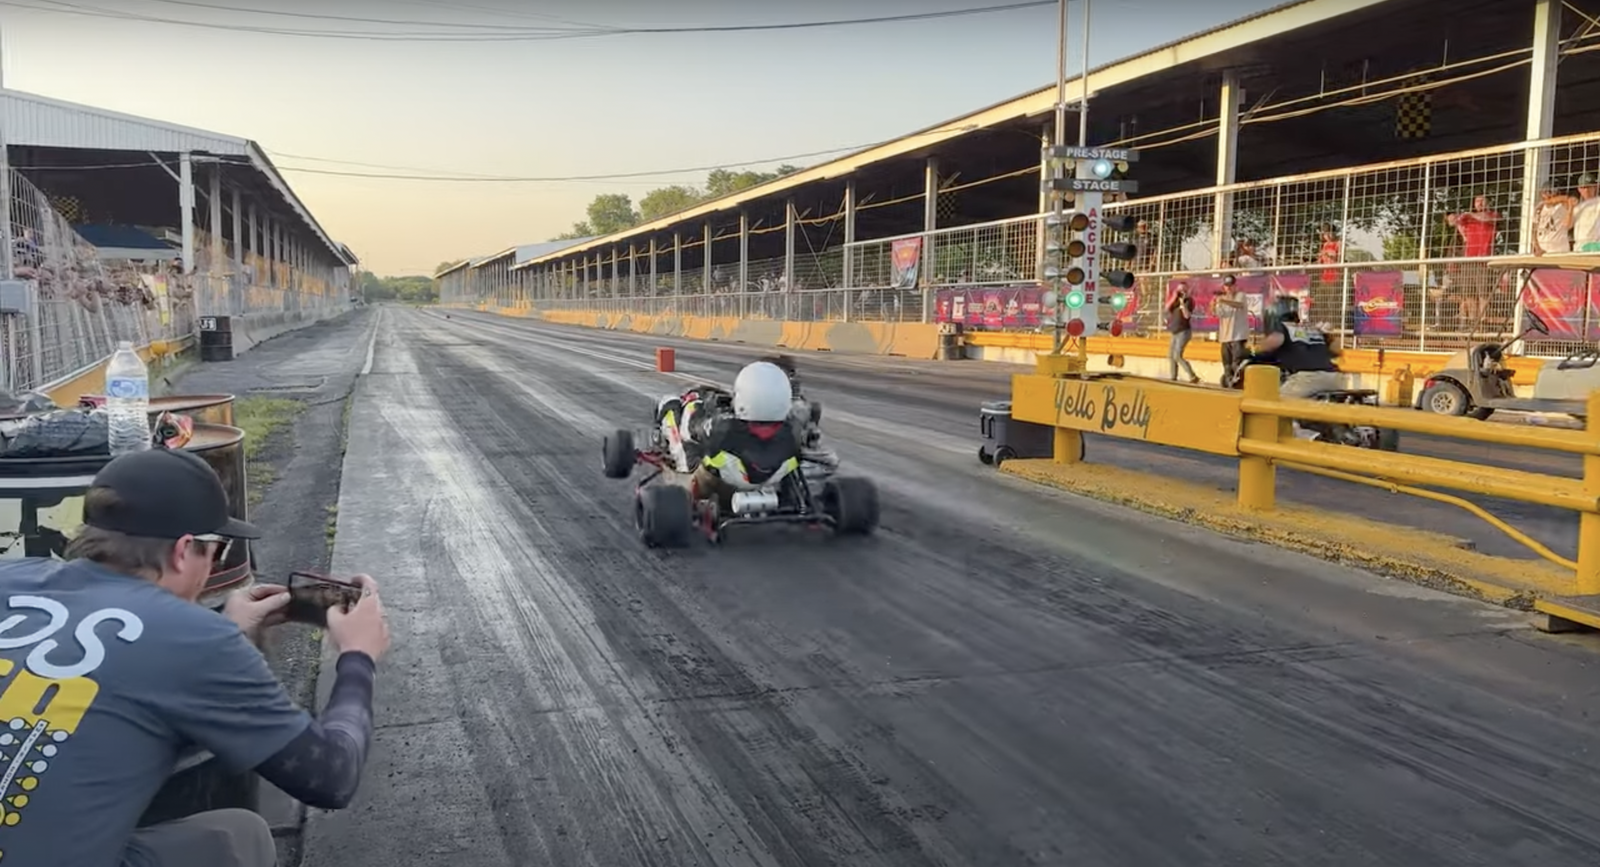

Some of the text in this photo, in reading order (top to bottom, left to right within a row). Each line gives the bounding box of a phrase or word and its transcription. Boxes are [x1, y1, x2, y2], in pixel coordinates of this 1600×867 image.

[1066, 147, 1128, 160] PRE-STAGE
[1073, 180, 1119, 191] STAGE
[1085, 207, 1098, 304] ACCUTIME
[1054, 380, 1151, 439] Yello Belly
